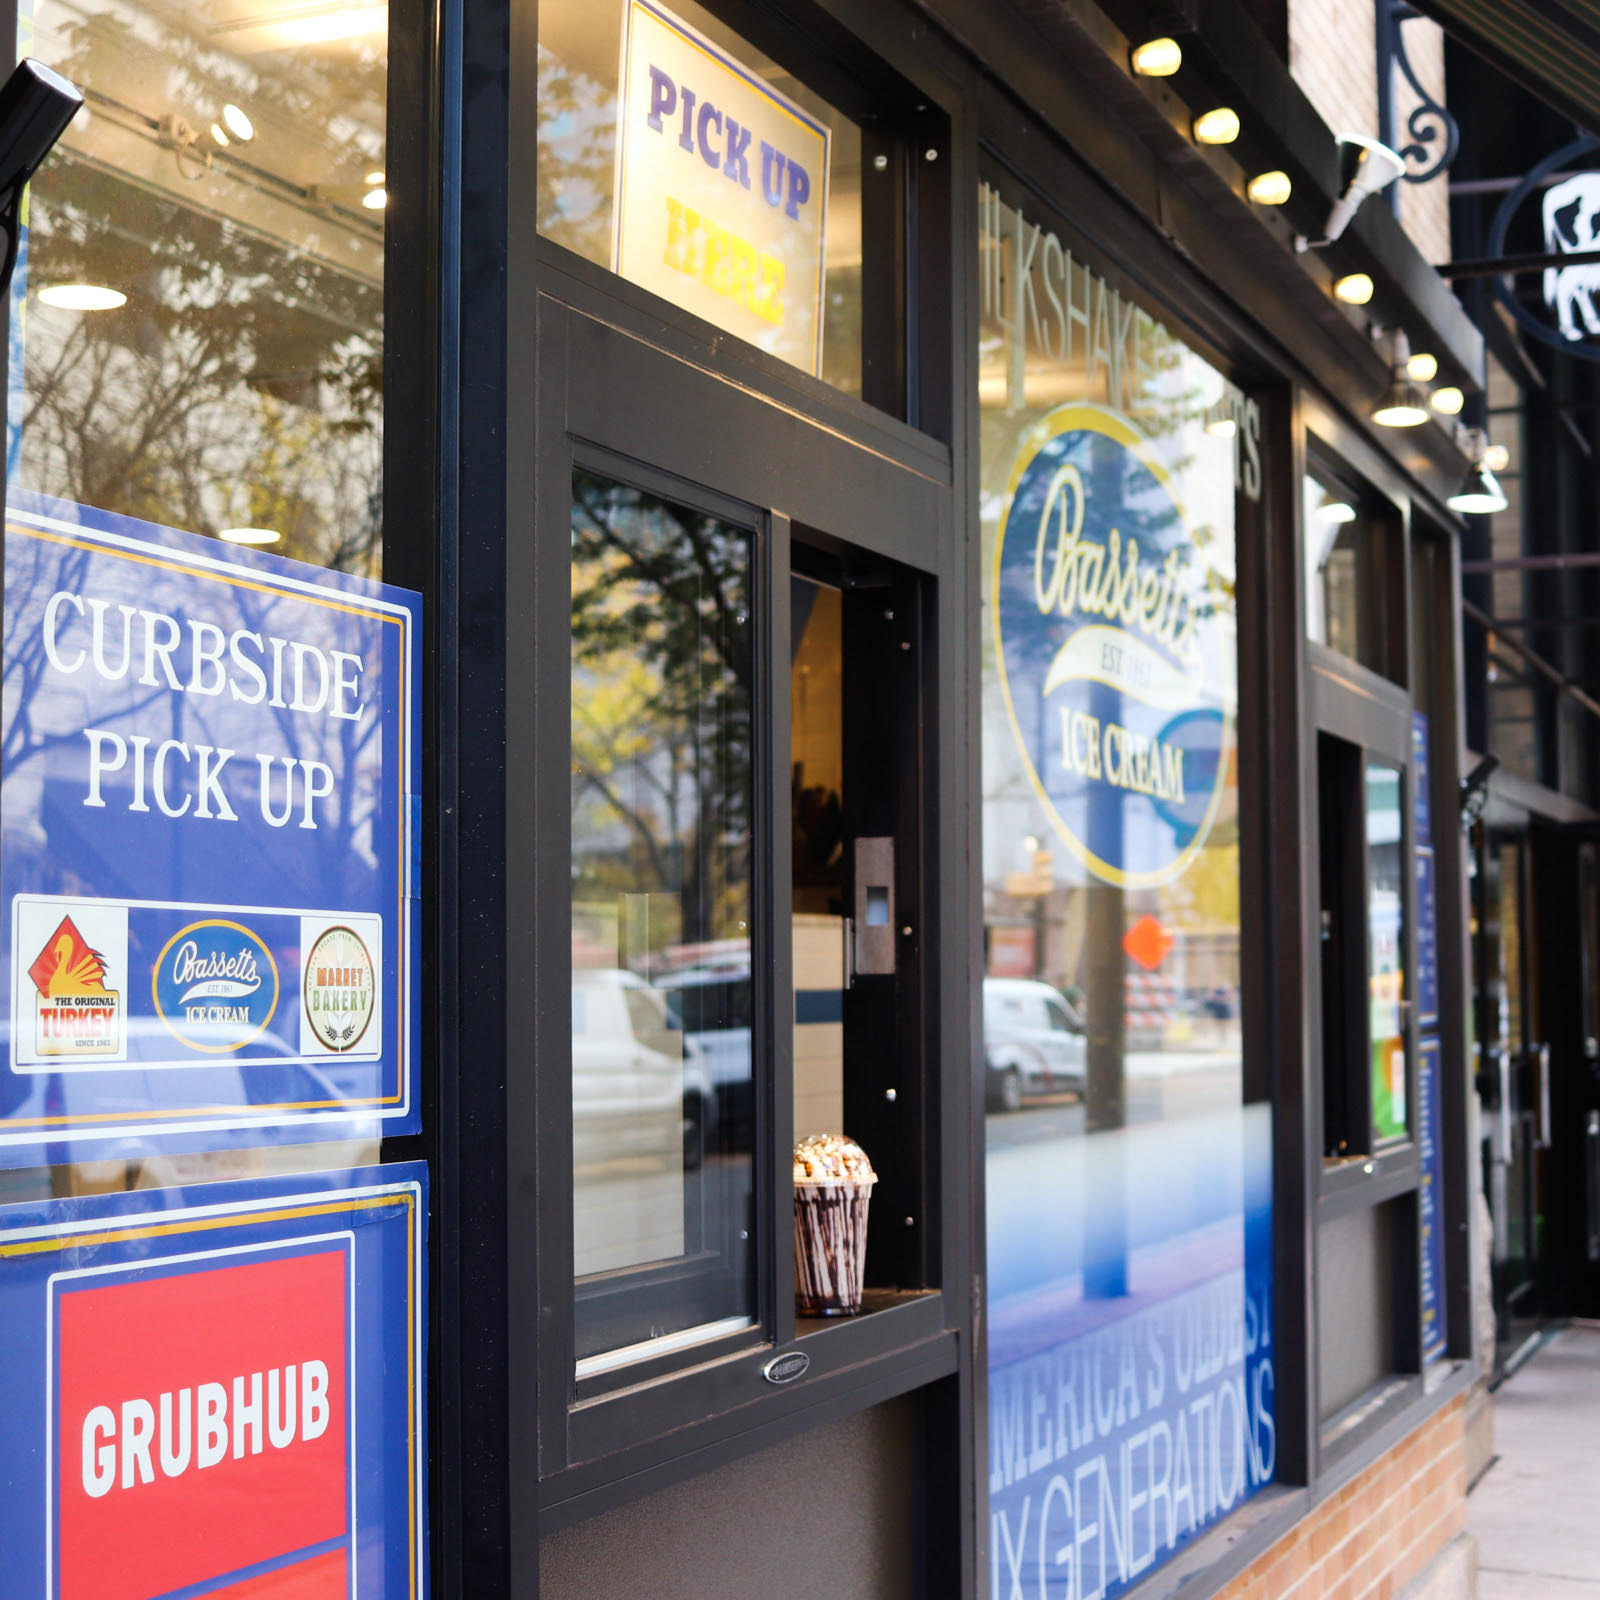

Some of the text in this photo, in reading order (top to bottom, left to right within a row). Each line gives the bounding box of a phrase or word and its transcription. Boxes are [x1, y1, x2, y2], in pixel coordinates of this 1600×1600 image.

[647, 63, 811, 222] PICK UP
[663, 194, 786, 327] HERE
[43, 591, 365, 721] CURBSIDE
[83, 728, 335, 830] PICK UP
[1059, 705, 1185, 805] ICE CREAM
[173, 941, 262, 986] Bassetts
[316, 967, 363, 987] MARKET
[40, 1007, 115, 1038] TURKEY
[55, 997, 116, 1006] THE ORIGINAL
[186, 1006, 250, 1024] ICE CREAM
[313, 989, 367, 1011] BAKERY
[75, 1039, 96, 1047] SINCE
[81, 1359, 330, 1498] GRUBHUB
[1038, 1357, 1276, 1600] GENERATIONS
